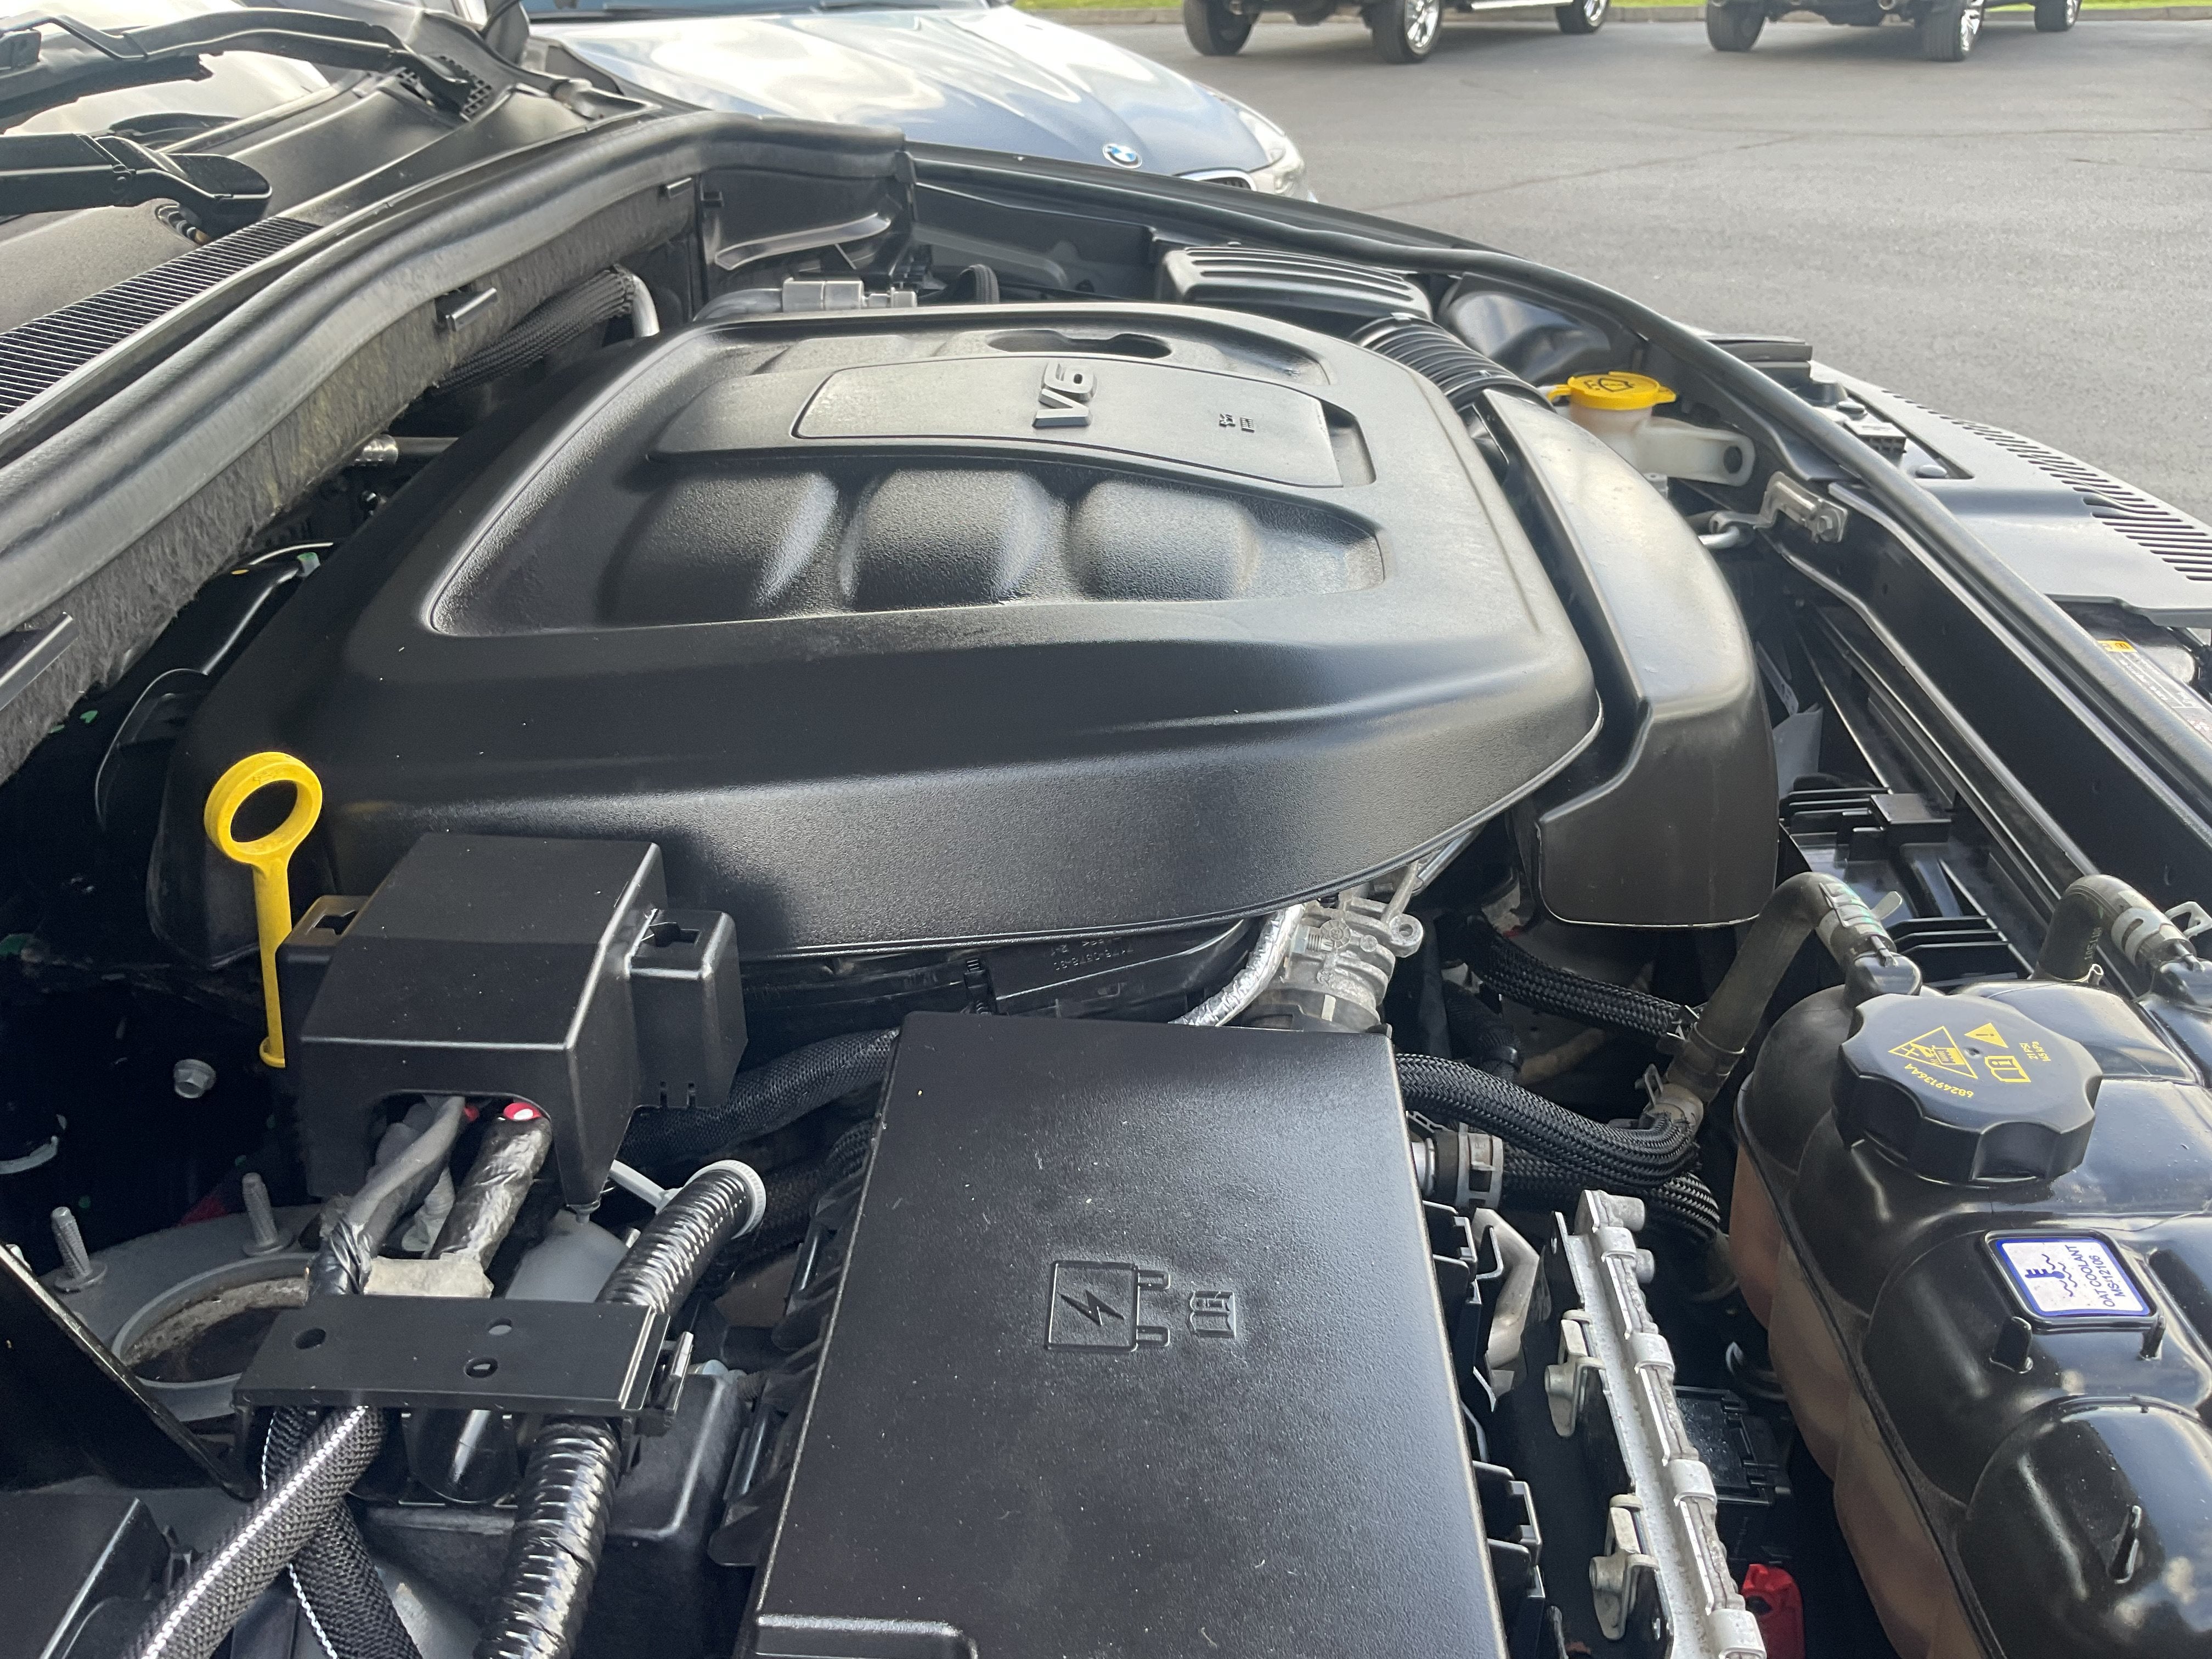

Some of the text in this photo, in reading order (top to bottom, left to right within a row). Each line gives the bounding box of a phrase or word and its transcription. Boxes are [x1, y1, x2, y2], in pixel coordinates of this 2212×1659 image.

[1032, 362, 1097, 428] V6
[2019, 1042, 2034, 1052] PSI
[2032, 1041, 2045, 1052] kPa
[1904, 1063, 1974, 1098] 68249136AA
[2064, 1244, 2116, 1307] OAT COOLANT
[2089, 1255, 2125, 1297] MS-12106
